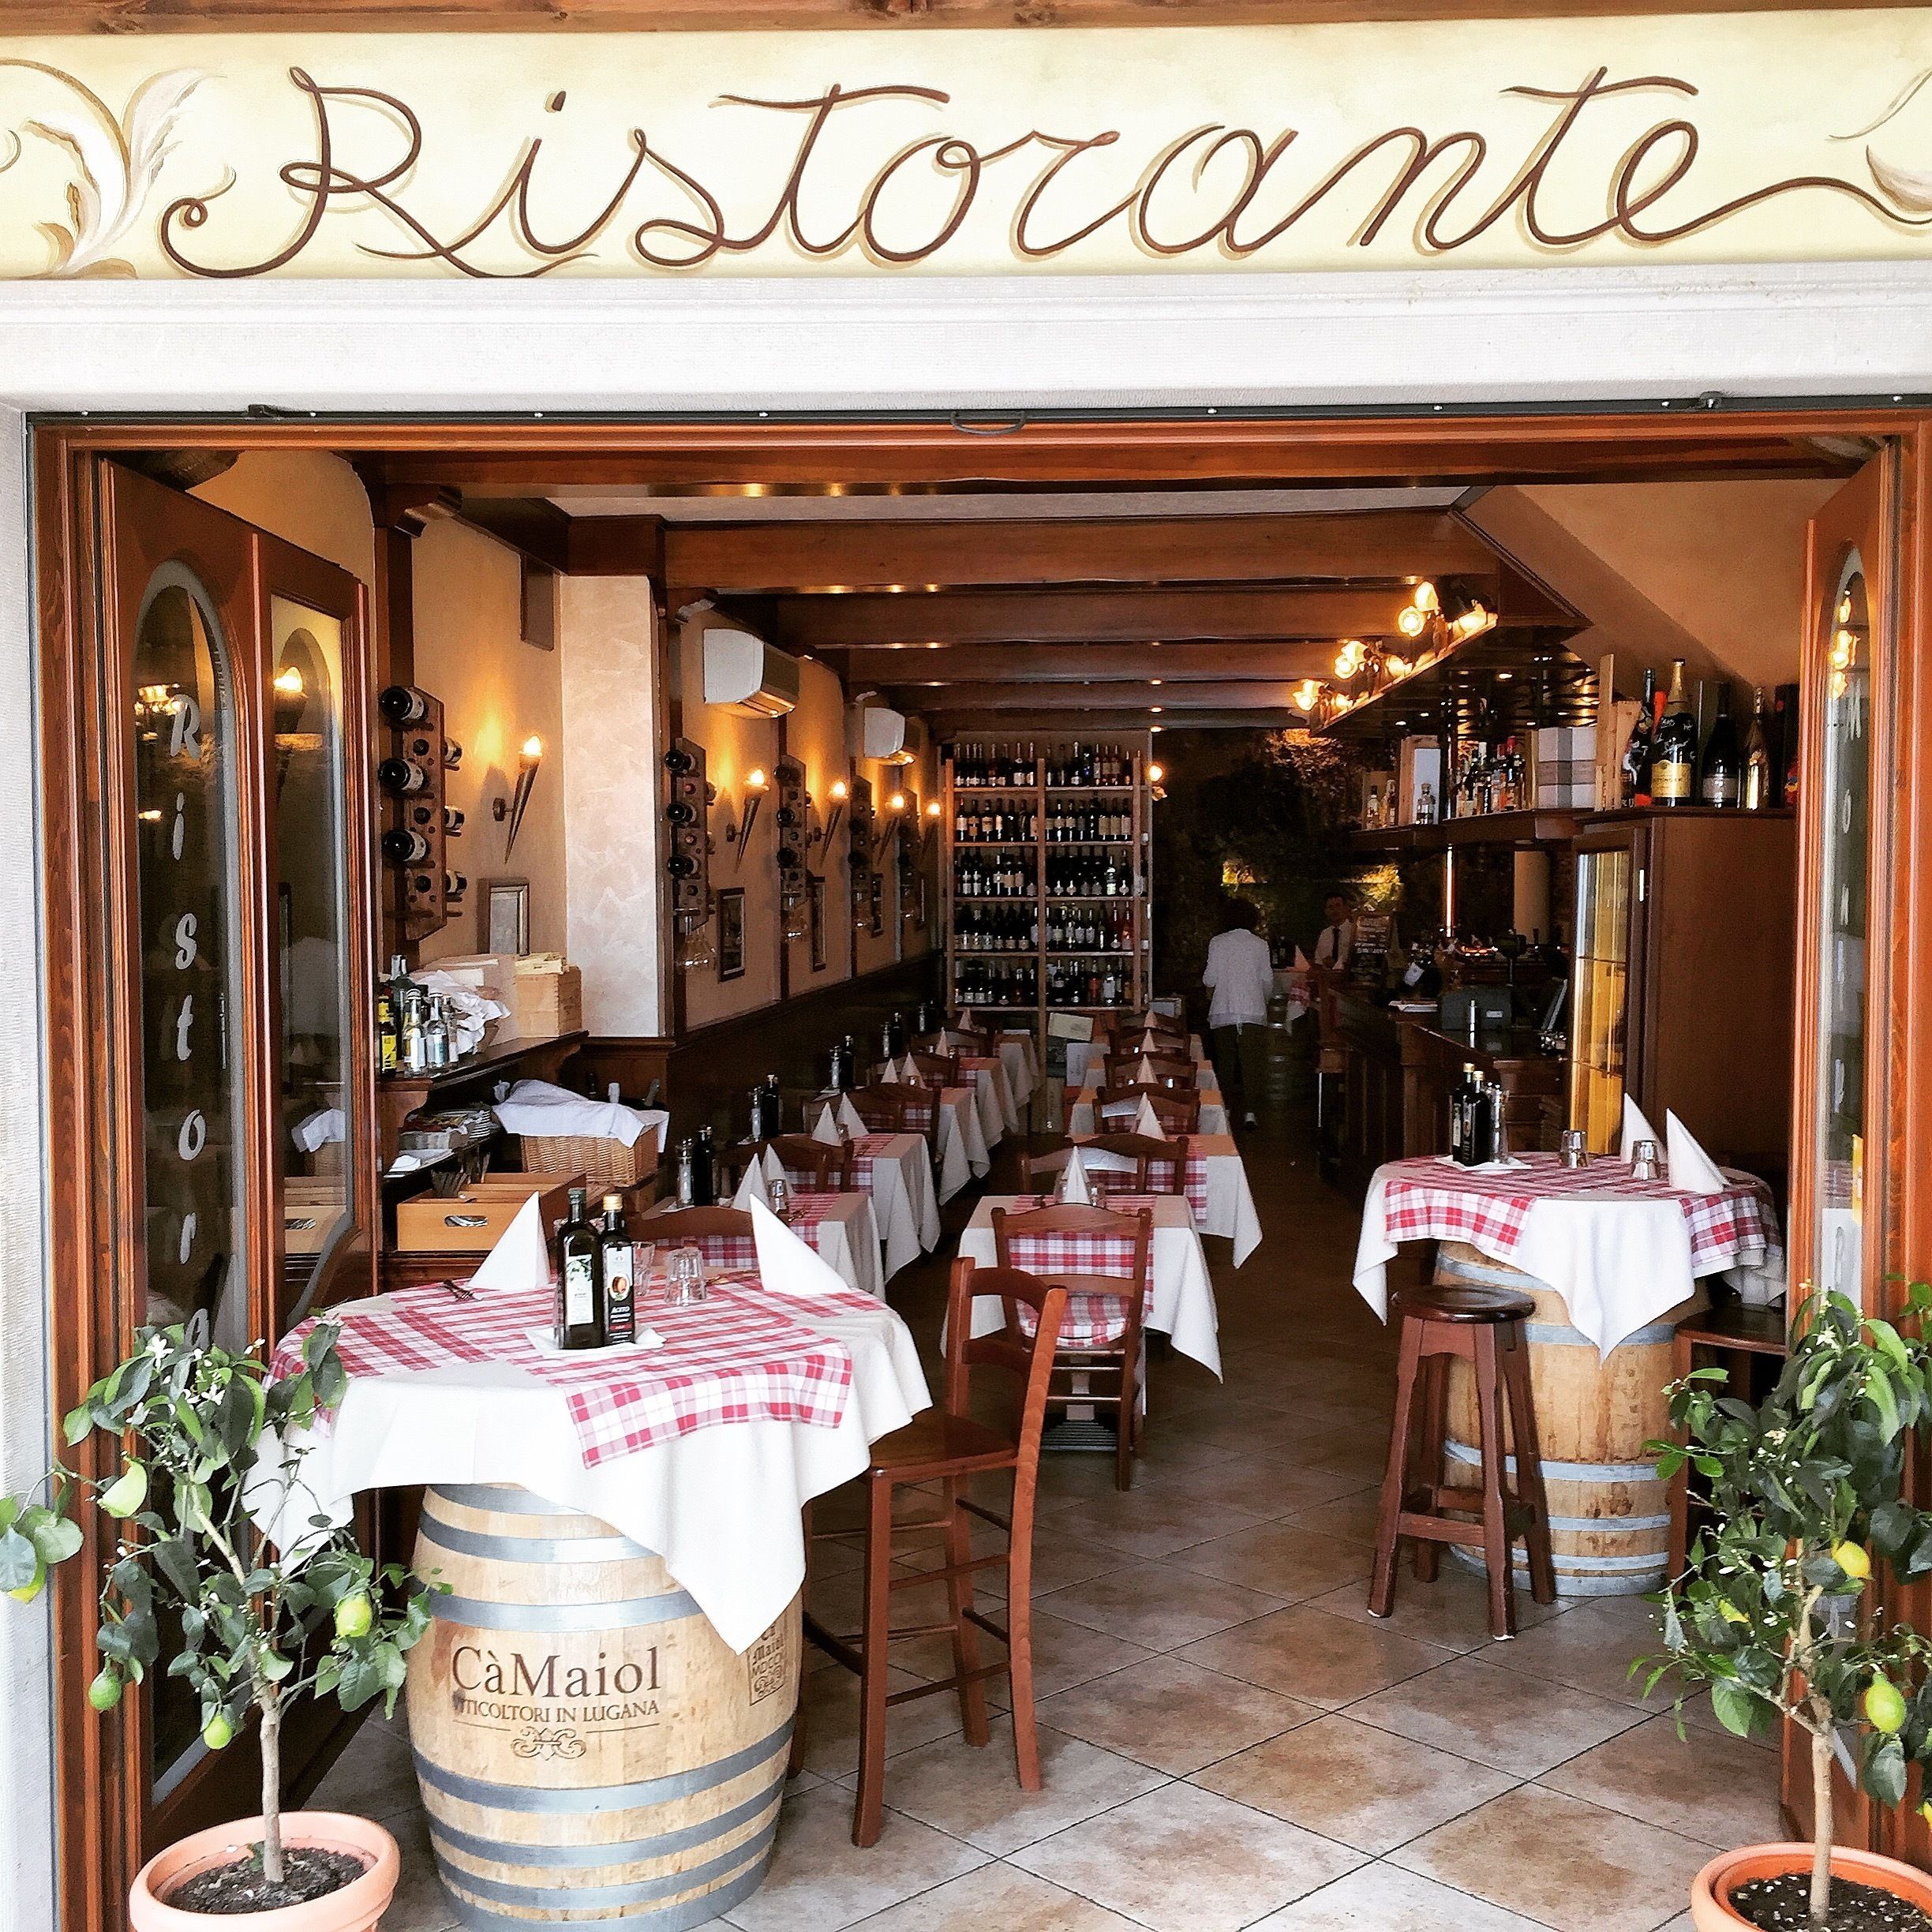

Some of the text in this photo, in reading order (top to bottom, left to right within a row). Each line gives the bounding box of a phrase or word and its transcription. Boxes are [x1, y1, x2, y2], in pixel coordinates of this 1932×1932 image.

[163, 66, 1910, 279] Ristorante
[452, 1646, 661, 1698] CàMaiol
[453, 1691, 661, 1723] ITICOLTORI IN LUGANA
